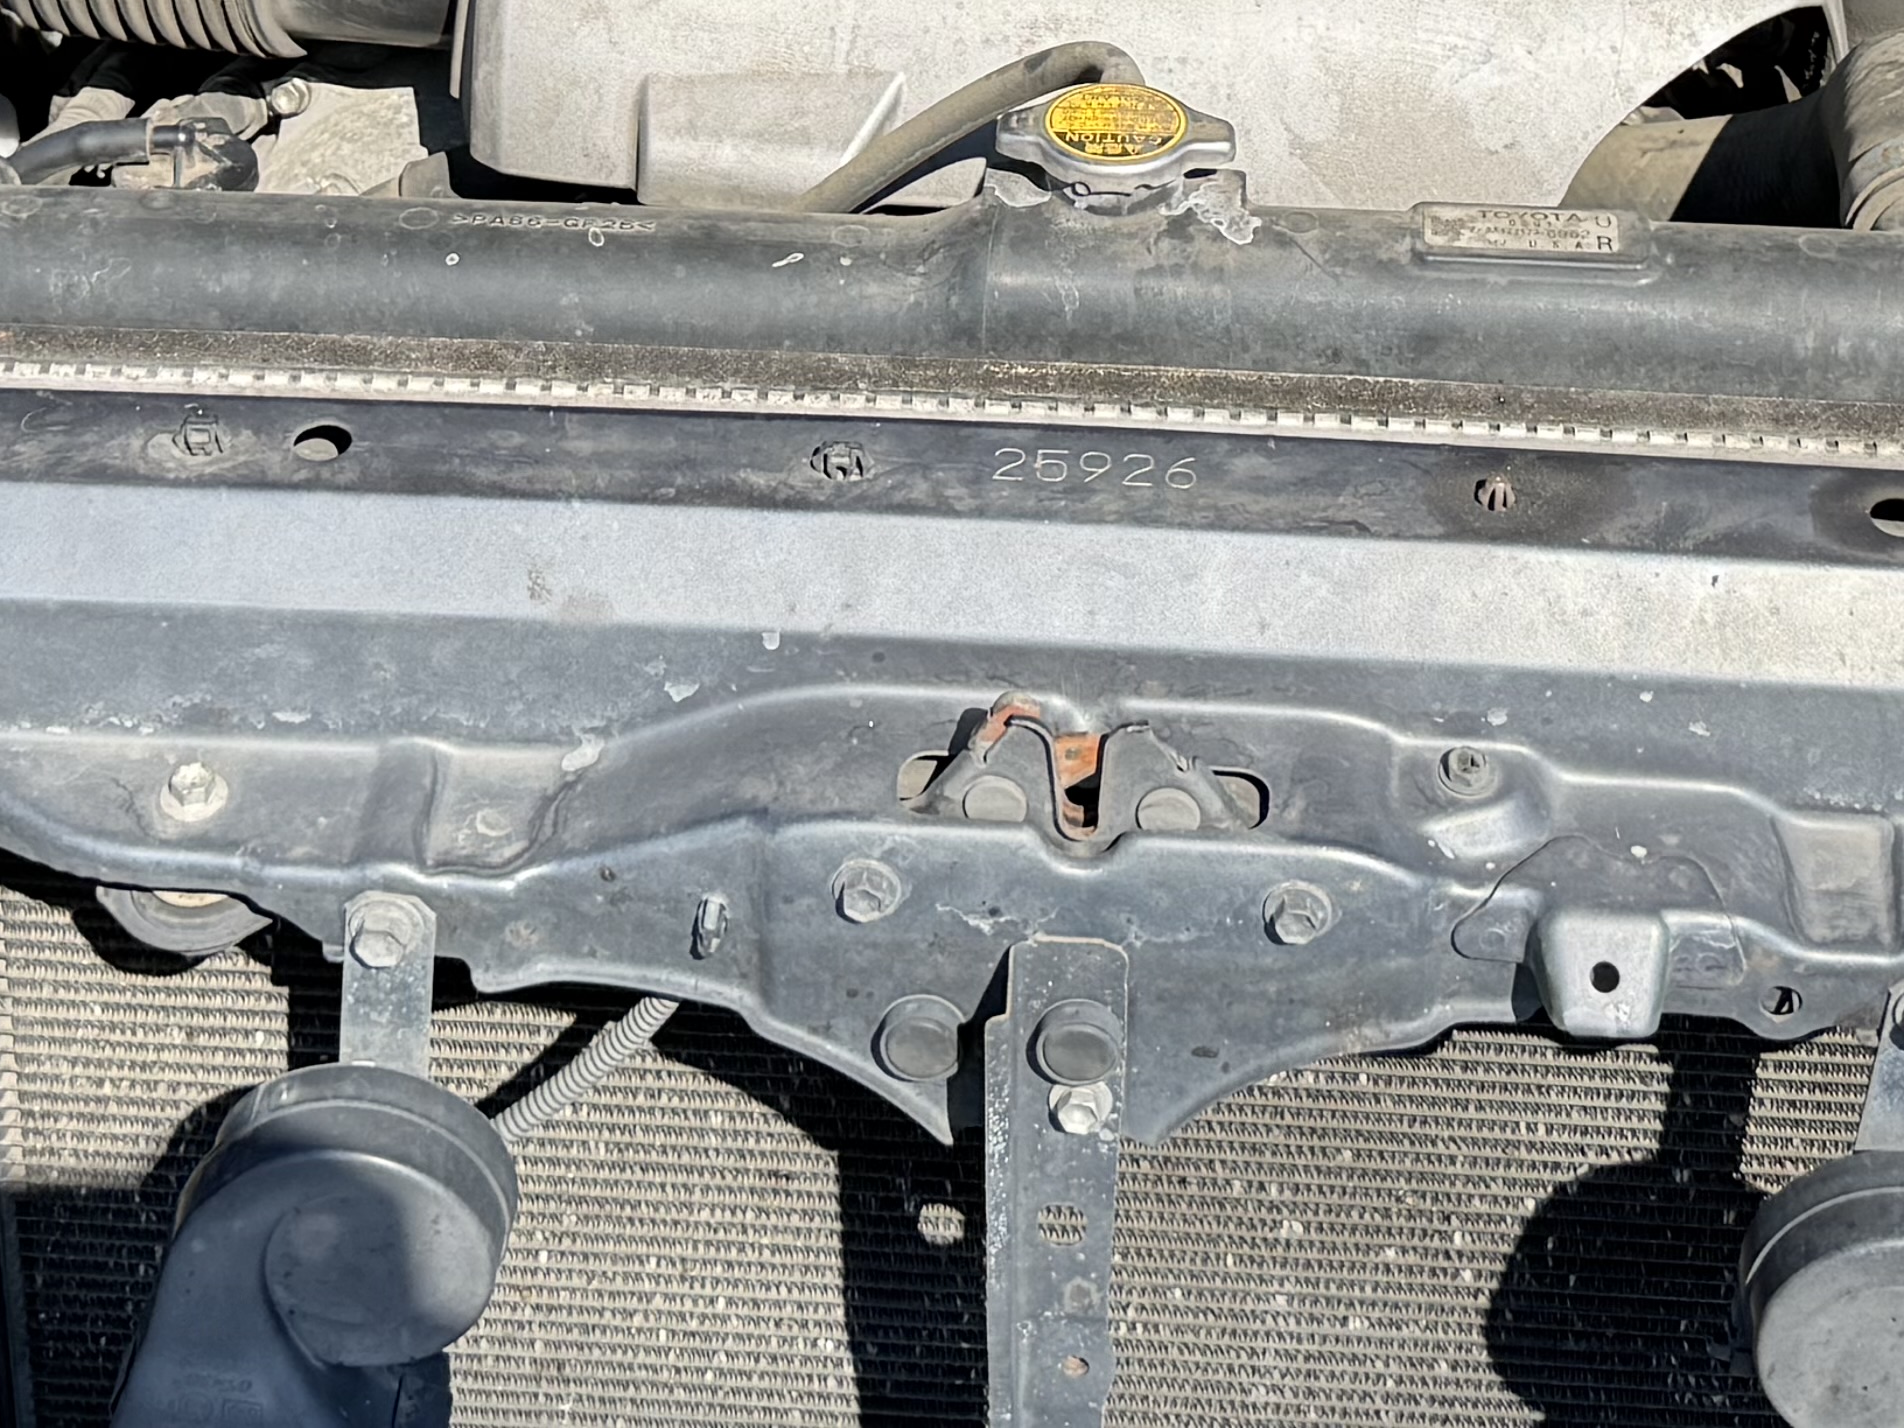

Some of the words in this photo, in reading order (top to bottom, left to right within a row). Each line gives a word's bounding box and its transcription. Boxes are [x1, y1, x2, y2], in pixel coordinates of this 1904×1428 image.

[1065, 131, 1164, 146] CAUTION
[1476, 209, 1585, 223] TOYOTA
[1596, 235, 1614, 252] R
[991, 446, 1199, 490] 25926
